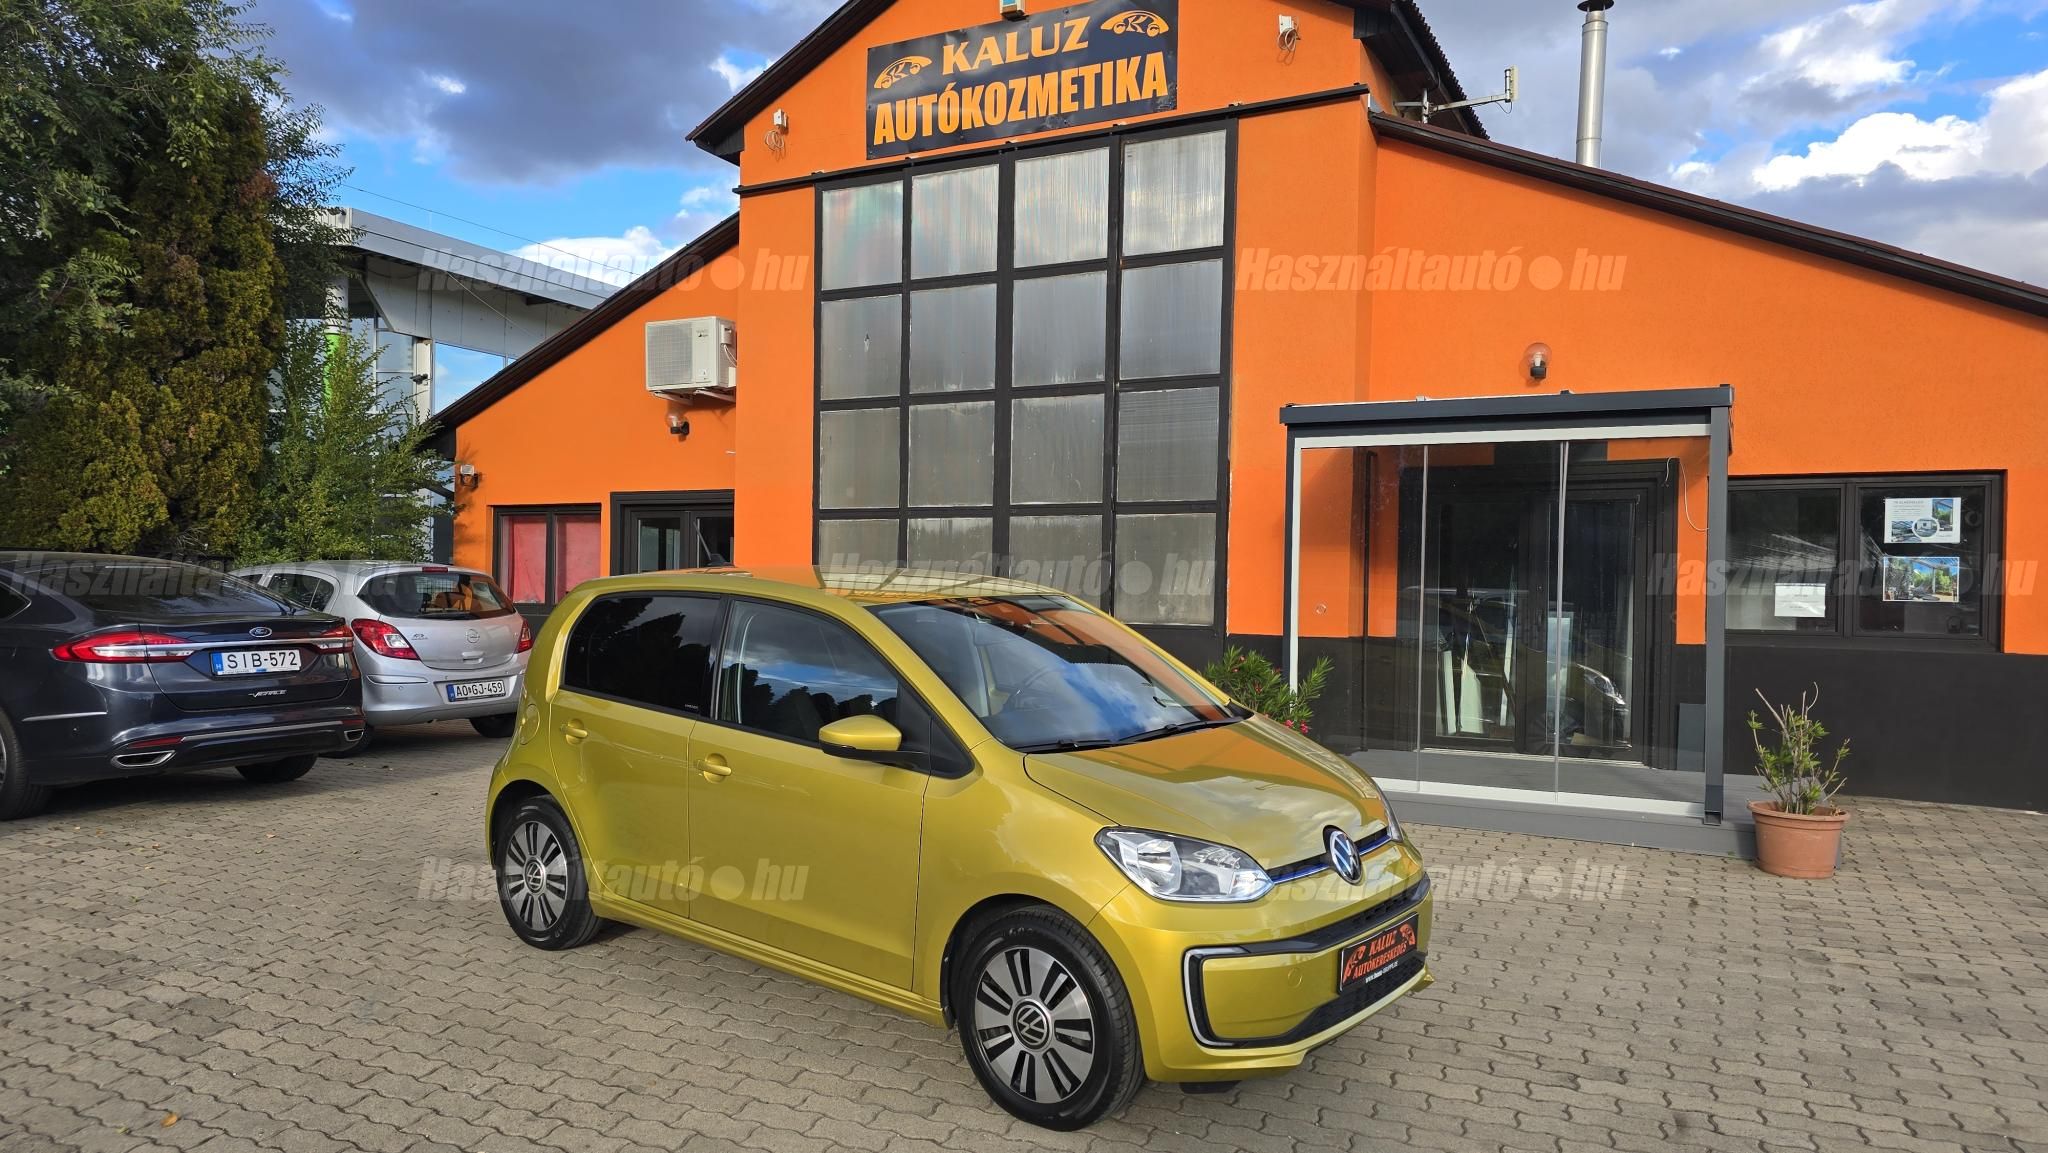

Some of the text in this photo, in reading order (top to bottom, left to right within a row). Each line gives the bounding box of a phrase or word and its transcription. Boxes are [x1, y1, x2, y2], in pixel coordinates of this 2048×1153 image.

[942, 16, 1091, 75] KALUZ
[873, 51, 1169, 146] AUTÓKOZMETIKA
[227, 652, 298, 669] SIB-572
